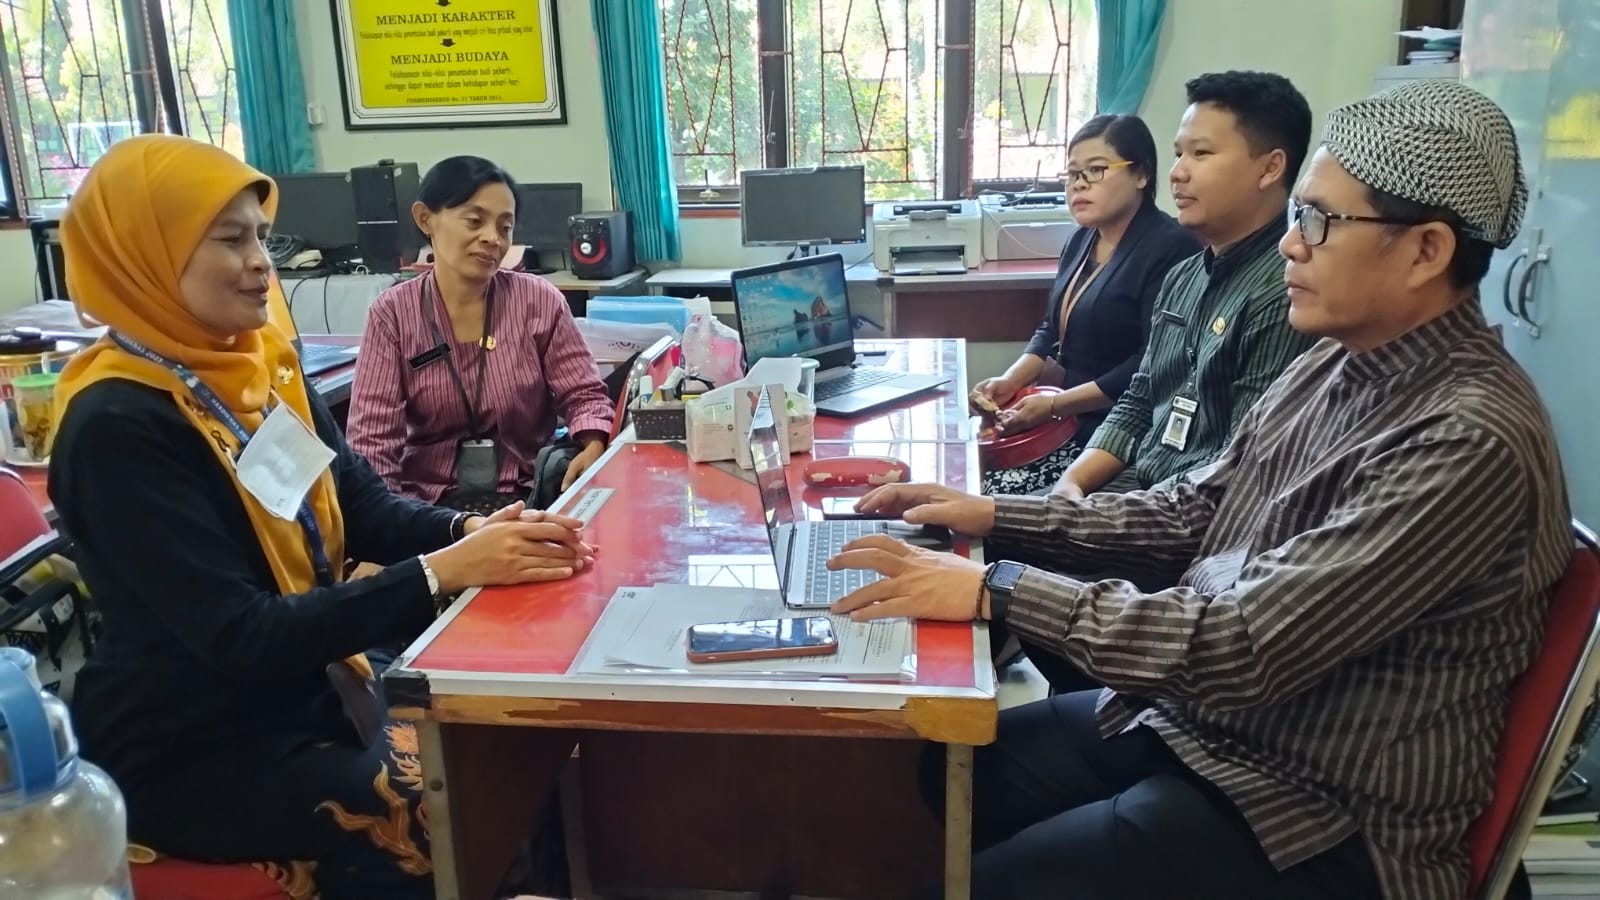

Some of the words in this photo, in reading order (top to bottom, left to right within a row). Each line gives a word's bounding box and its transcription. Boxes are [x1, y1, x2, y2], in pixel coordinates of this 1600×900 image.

[376, 13, 437, 25] MENJADI
[442, 10, 516, 23] KARAKTER
[391, 53, 451, 65] MENJADI
[456, 51, 510, 62] BUDAYA
[145, 351, 163, 363] 2023
